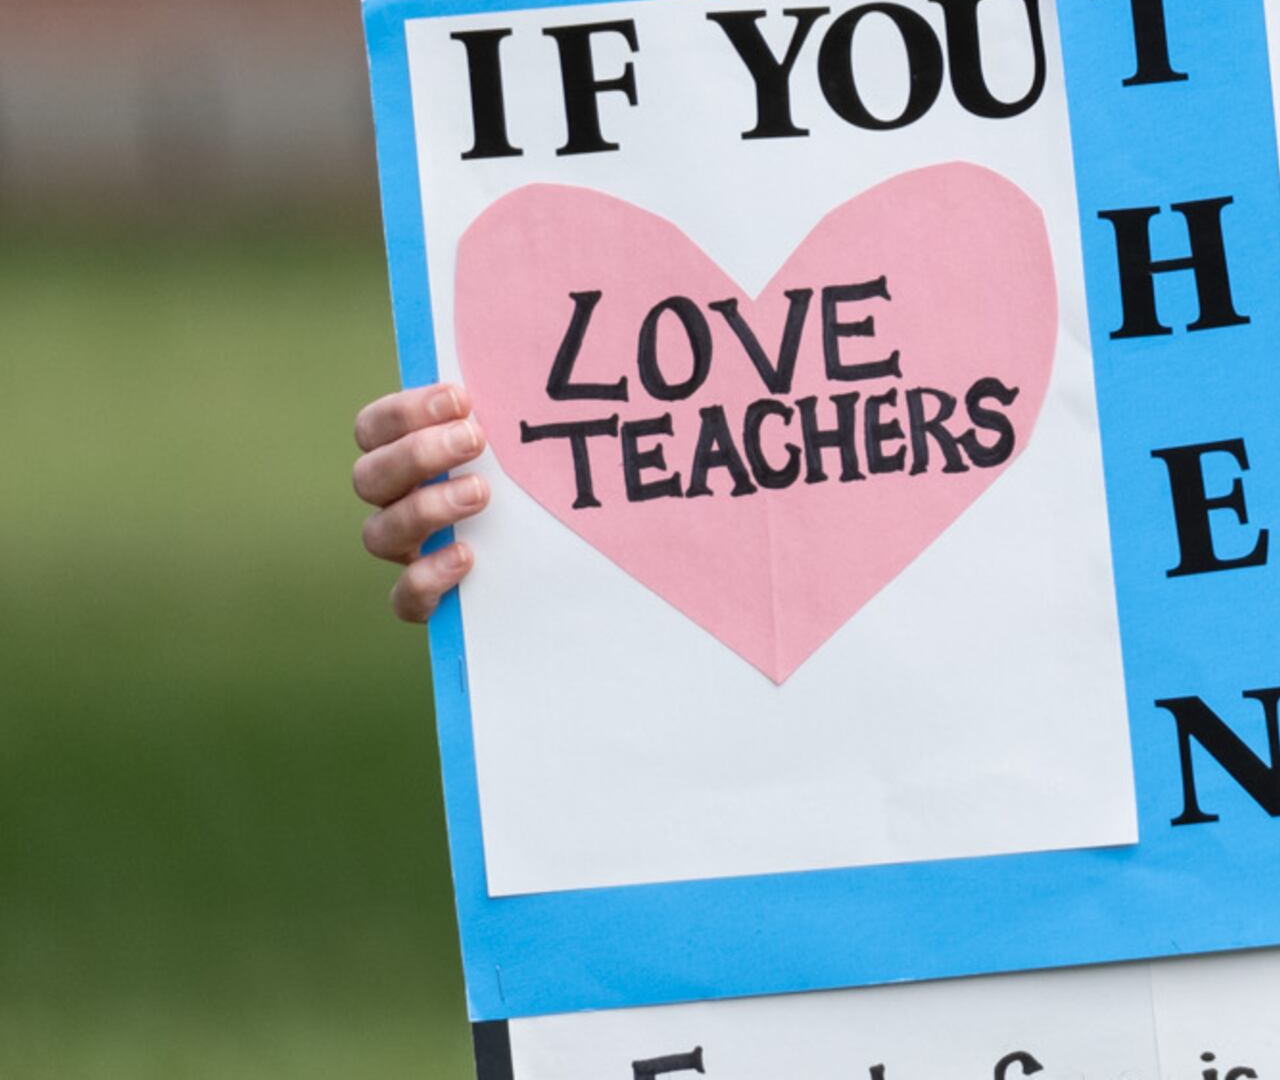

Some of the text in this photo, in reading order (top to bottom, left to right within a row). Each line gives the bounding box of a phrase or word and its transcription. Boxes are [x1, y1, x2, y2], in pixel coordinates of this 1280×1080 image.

[450, 19, 640, 160] IF
[546, 275, 903, 402] LOVE
[519, 376, 1020, 509] TEACHERS
